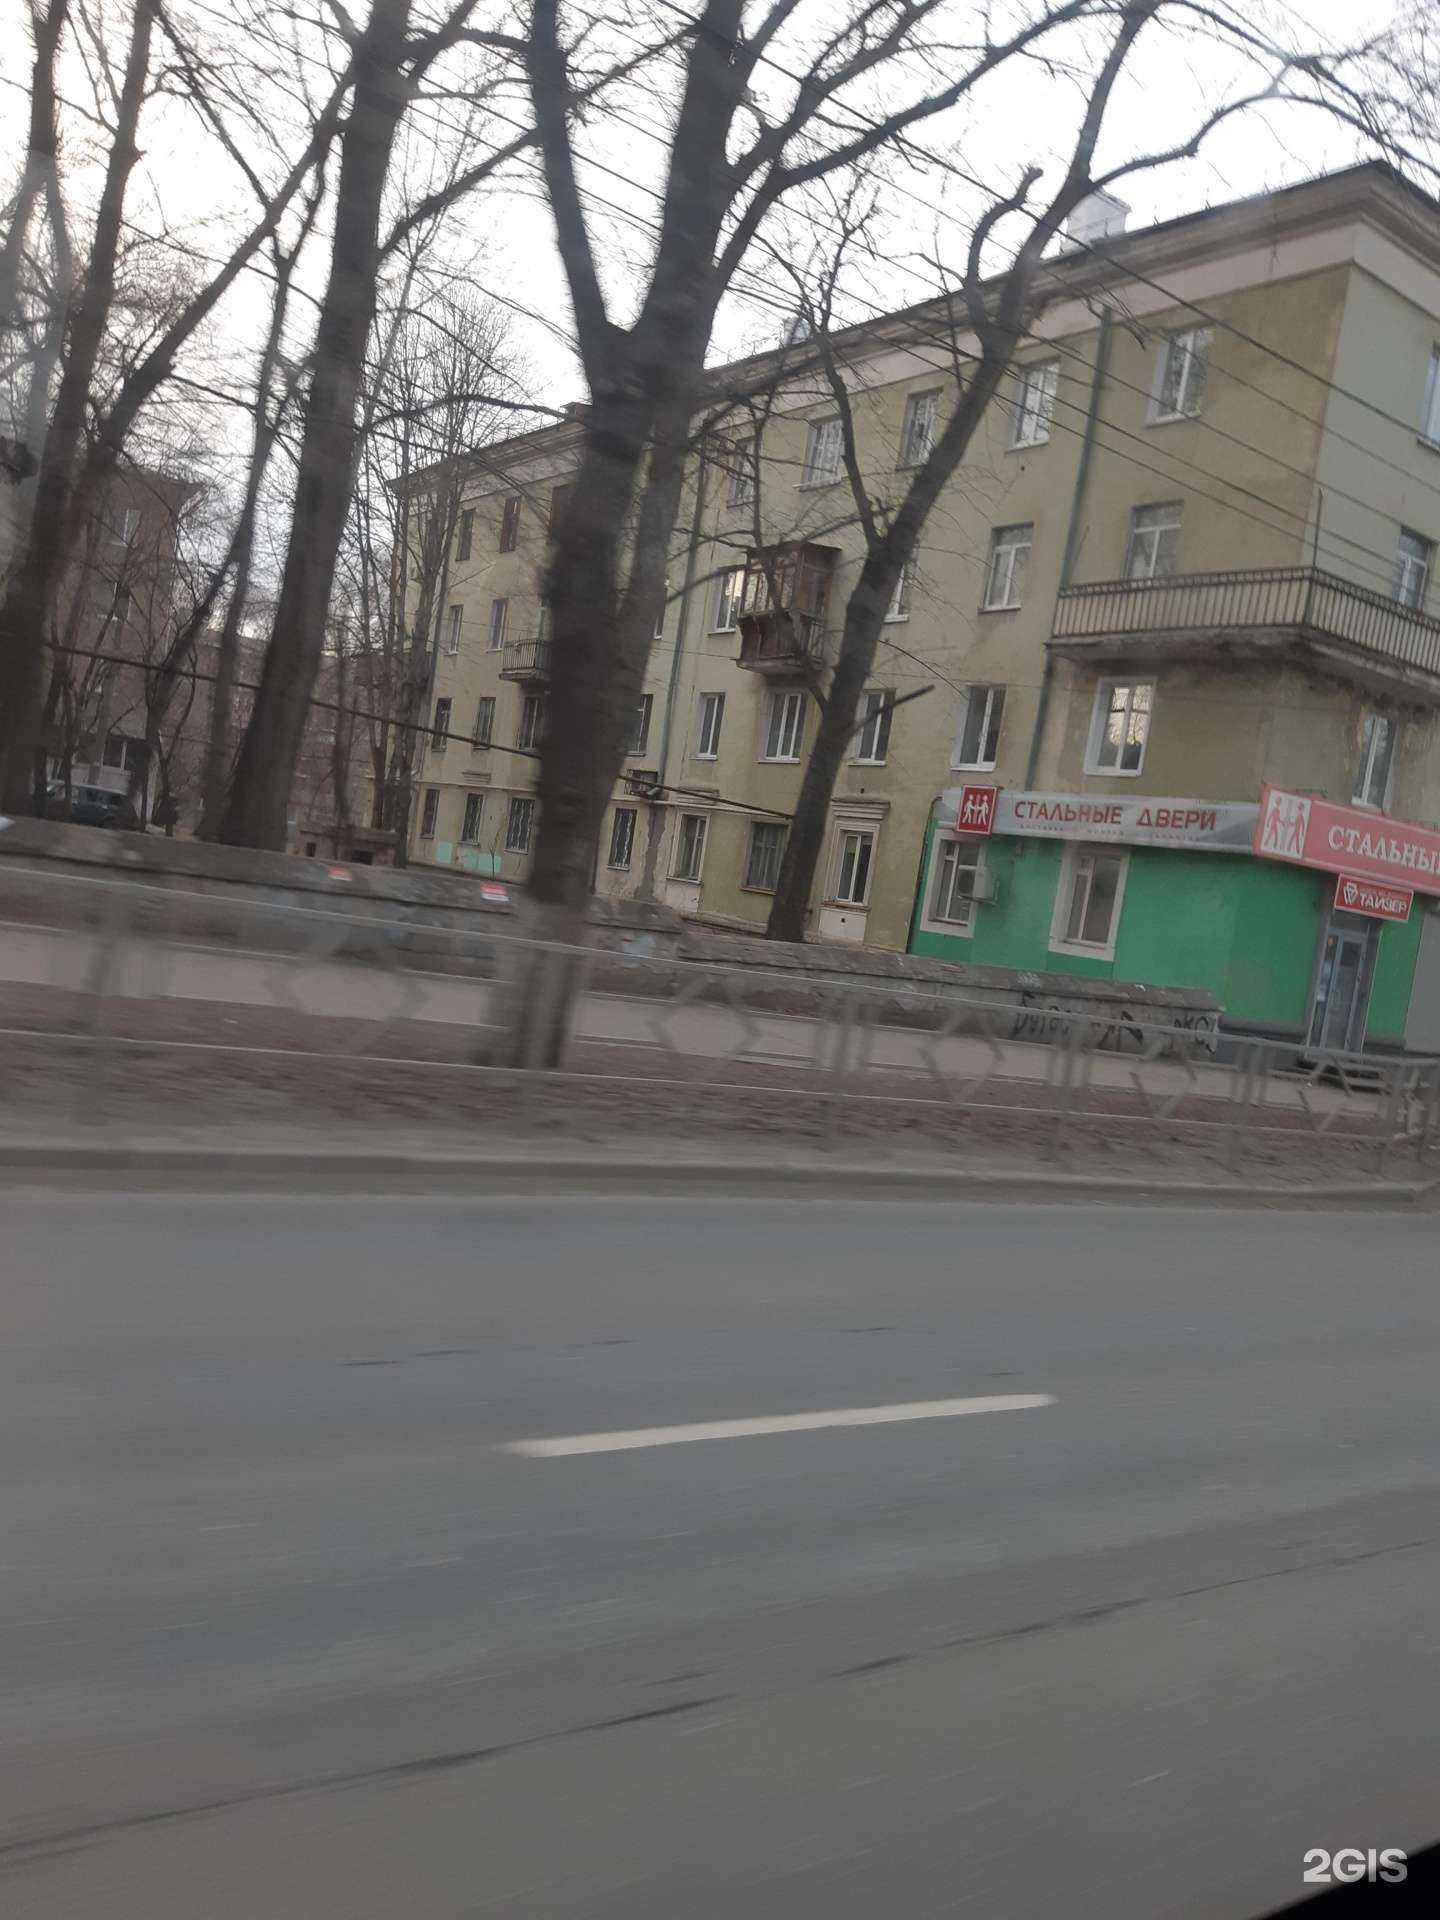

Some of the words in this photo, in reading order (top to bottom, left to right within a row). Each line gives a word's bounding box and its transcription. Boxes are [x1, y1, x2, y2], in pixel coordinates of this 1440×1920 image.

[1014, 801, 1124, 825] СТАЛЬНЫЕ
[1136, 807, 1216, 831] ДВЕРИ
[1328, 825, 1440, 874] СТАЛЬНЫ
